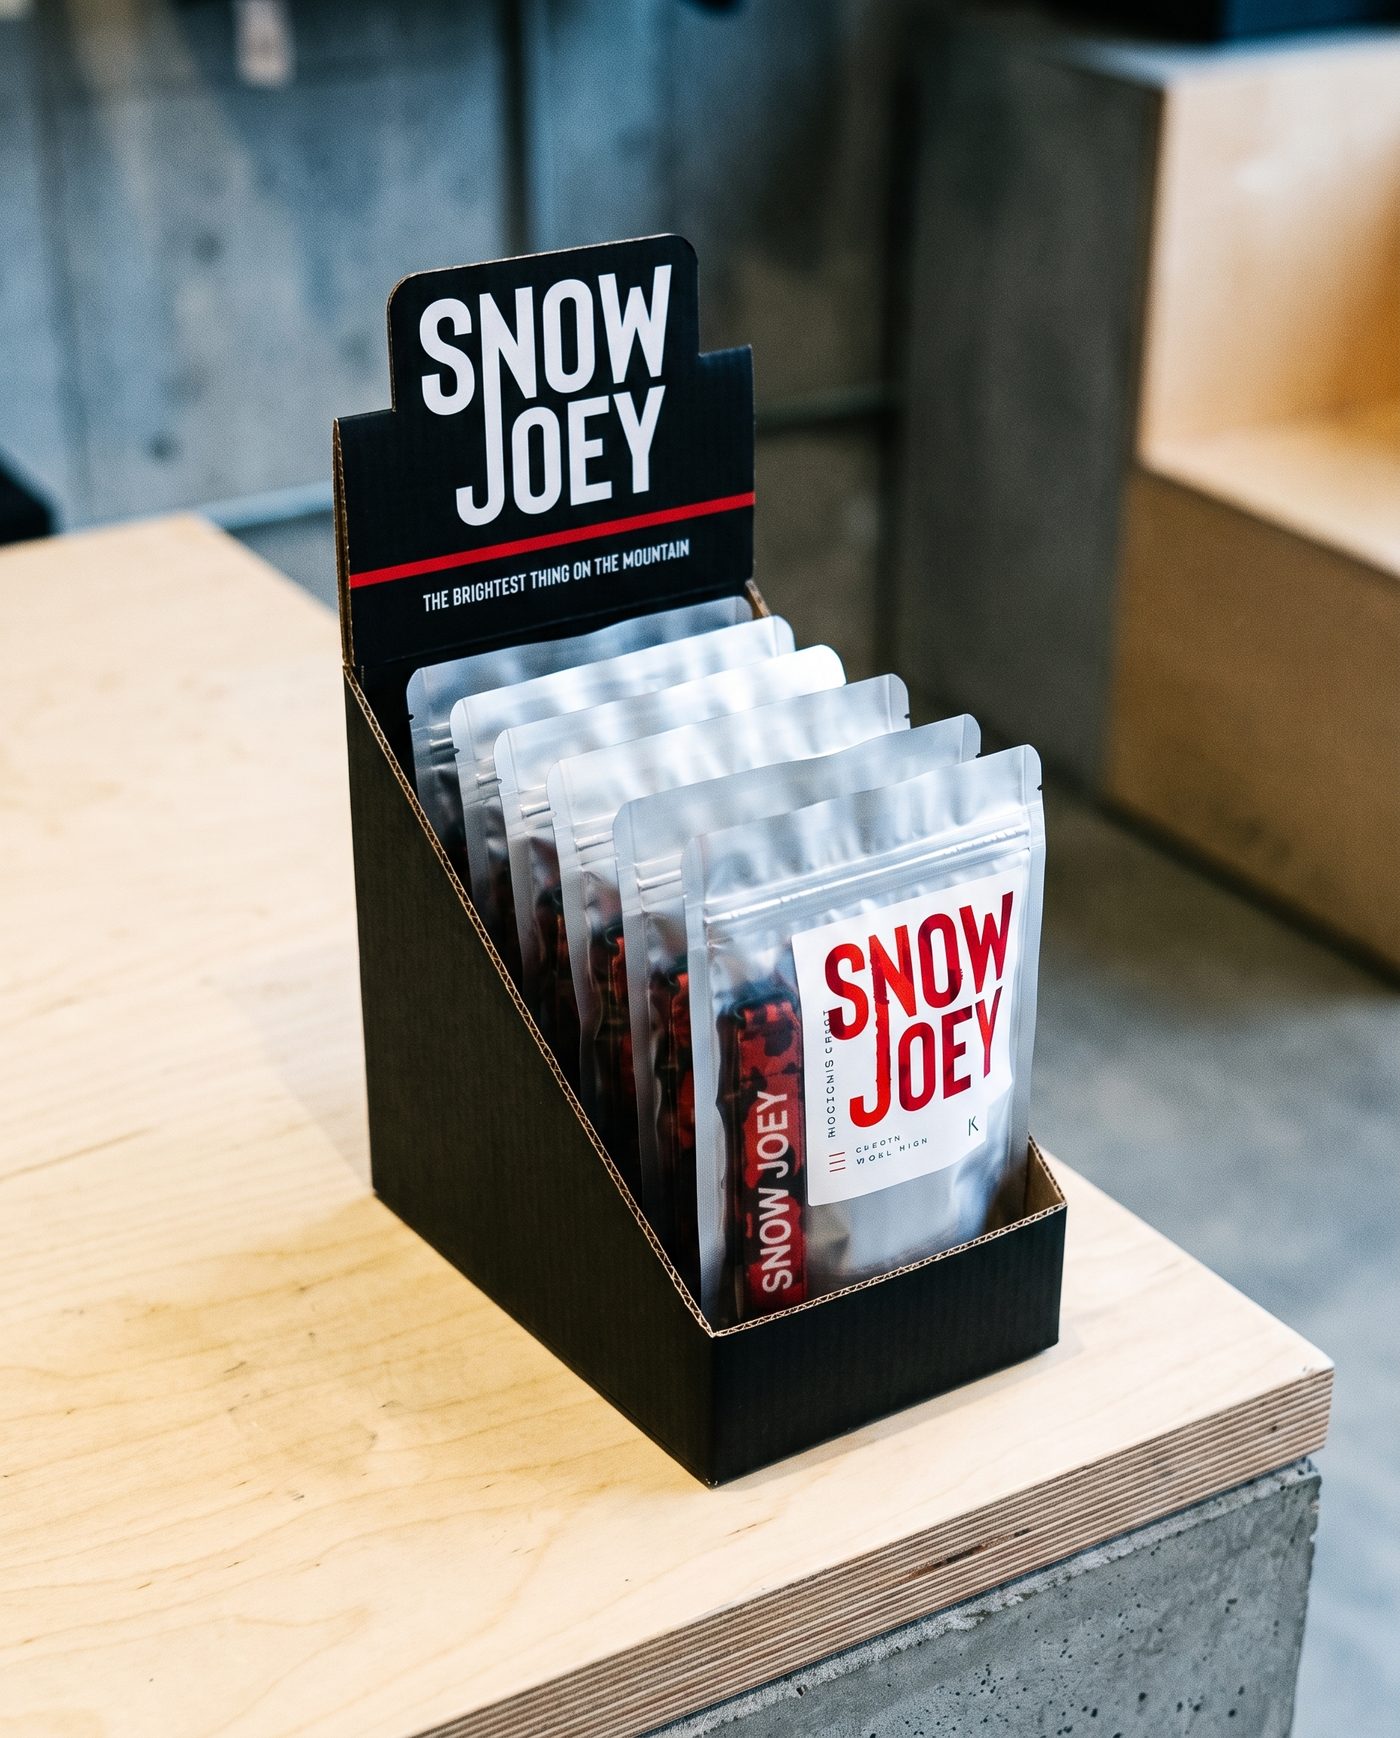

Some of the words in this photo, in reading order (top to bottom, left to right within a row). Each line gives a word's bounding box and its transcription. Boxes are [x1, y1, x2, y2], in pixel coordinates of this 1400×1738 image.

[419, 264, 672, 416] SNOW
[456, 385, 666, 526] JOEY
[423, 590, 449, 612] THE
[453, 573, 526, 606] BRIGHTEST
[530, 565, 570, 589] THING
[573, 560, 592, 580] ON
[594, 554, 619, 576] THE
[622, 538, 690, 570] MOUNTAIN
[824, 890, 1014, 1040] SNOW
[850, 985, 1003, 1127] JOEY
[756, 1090, 789, 1179] JOEY
[757, 1187, 793, 1293] SNOW
